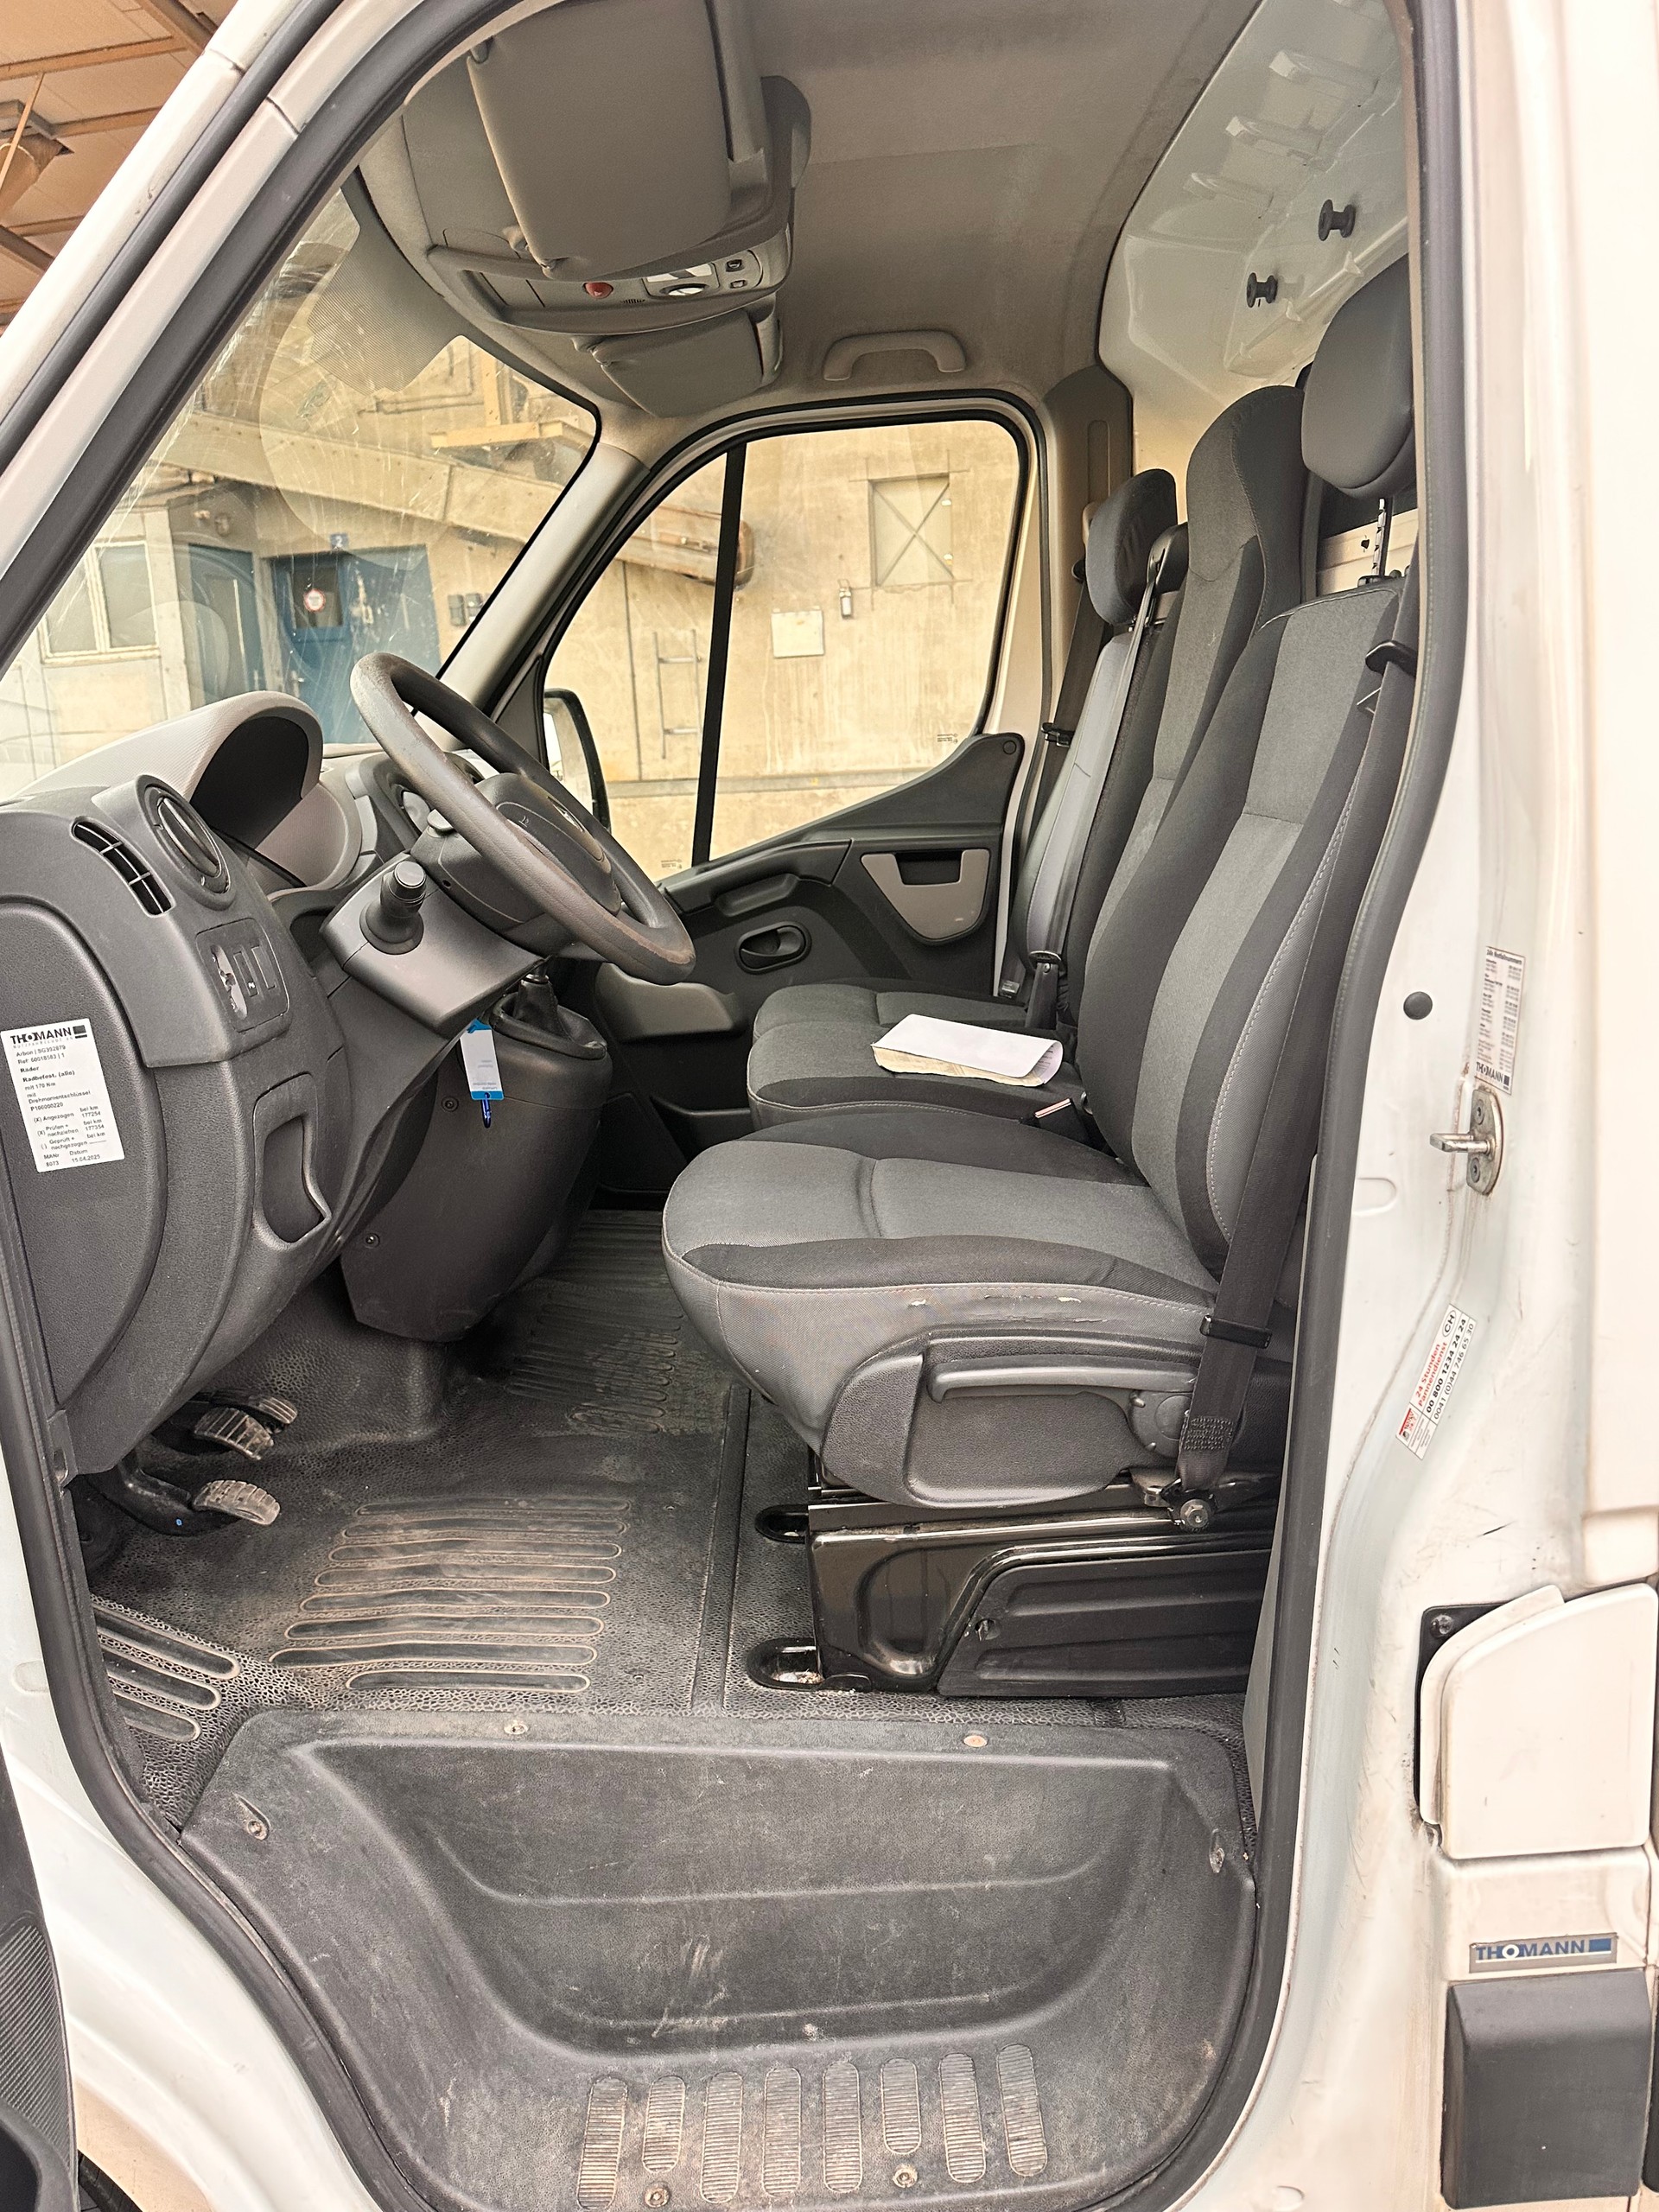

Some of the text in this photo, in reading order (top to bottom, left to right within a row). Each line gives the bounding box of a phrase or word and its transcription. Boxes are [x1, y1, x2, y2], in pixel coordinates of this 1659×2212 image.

[10, 1027, 72, 1044] THOMANN
[1444, 1314, 1455, 1333] CH
[1416, 1344, 1440, 1397] 24 Stunden
[1418, 1342, 1447, 1407] Pannendienst
[1427, 1319, 1466, 1413] 00 800 1234 24 24
[1434, 1397, 1446, 1420] 0041
[1445, 1371, 1457, 1395] (0)44
[1455, 1351, 1464, 1369] 746
[1462, 1338, 1469, 1350] 65
[1476, 1939, 1585, 1960] THOMANN
